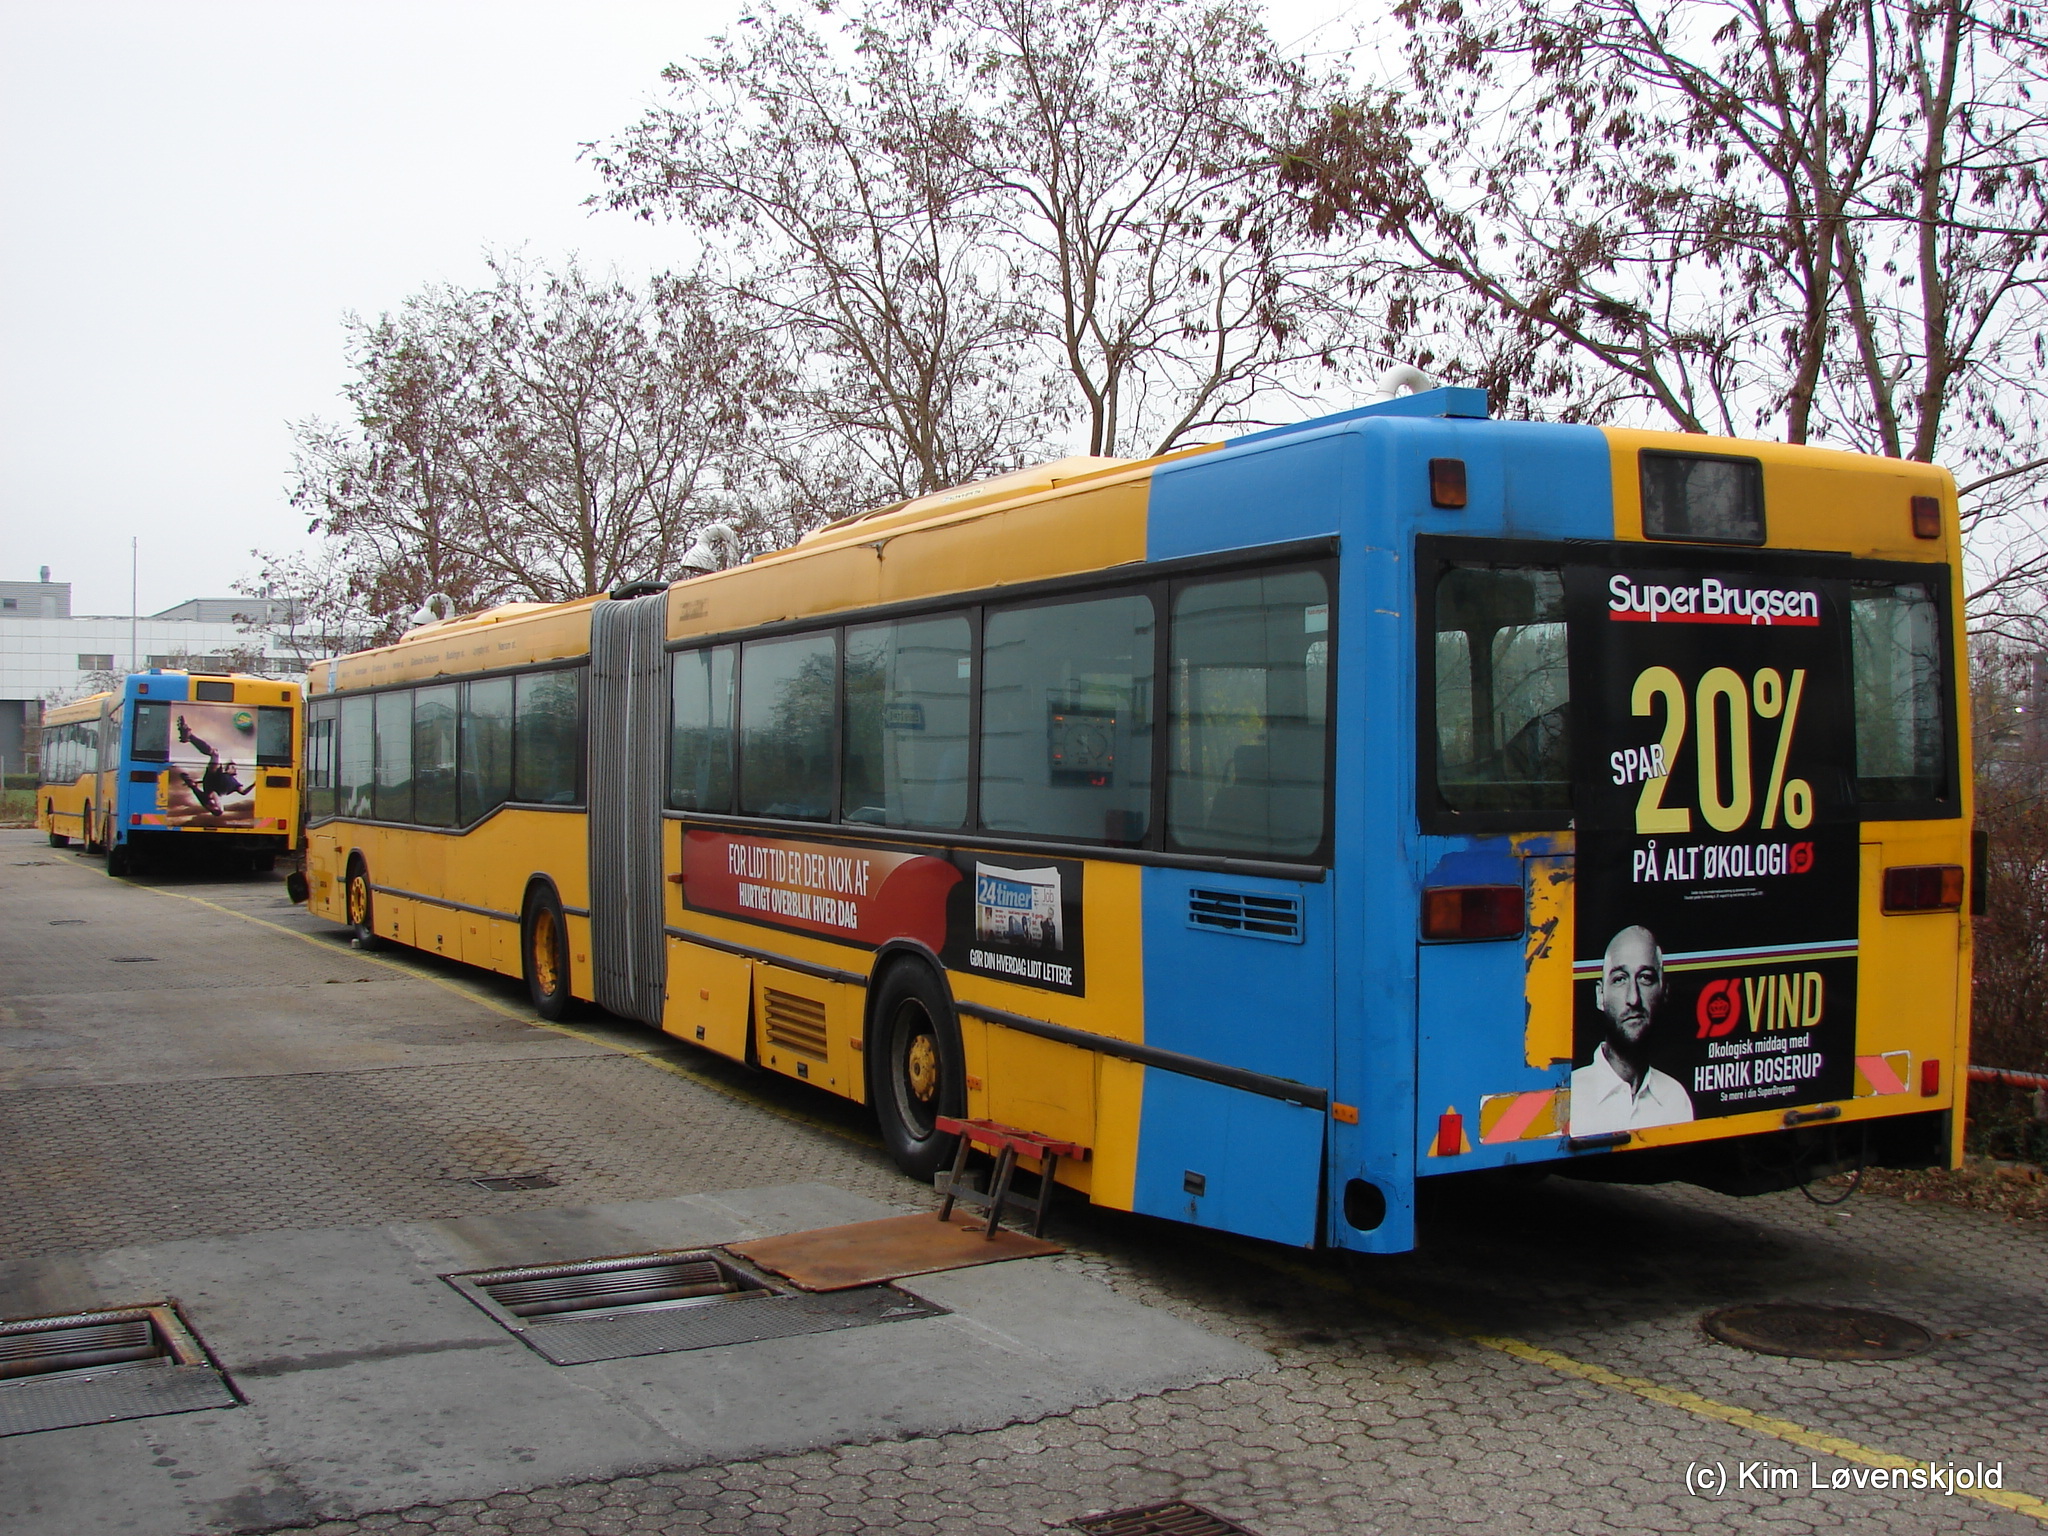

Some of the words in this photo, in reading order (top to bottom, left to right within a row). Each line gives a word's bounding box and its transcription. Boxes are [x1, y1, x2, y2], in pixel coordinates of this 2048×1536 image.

[1608, 574, 1820, 626] SuperBrugsen
[1610, 743, 1668, 786] SPAR
[1631, 666, 1814, 835] 20%
[728, 843, 747, 877] FOR
[748, 845, 768, 880] LIDT
[769, 848, 786, 883] TID
[788, 850, 802, 886] ER
[804, 852, 826, 890] DER
[828, 855, 853, 895] NOK
[854, 859, 870, 897] AF
[1633, 839, 1659, 883] PÅ
[1703, 843, 1787, 880] ØKOLOGI
[739, 881, 771, 912] HURTIGT
[771, 887, 812, 921] OVERBLIK
[813, 894, 837, 926] HVER
[837, 899, 858, 930] DAG
[969, 948, 984, 968] GØR
[984, 951, 996, 971] DIN
[996, 953, 1026, 977] HVERDAG
[1027, 959, 1042, 980] LIDT
[1042, 962, 1073, 986] LETTERE
[1744, 970, 1823, 1033] VIND
[1708, 1038, 1754, 1060] Økologisk
[1755, 1035, 1787, 1054] middag
[1789, 1031, 1810, 1049] med
[1694, 1060, 1751, 1093] HENRIK
[1754, 1052, 1823, 1085] BOSERUP
[1720, 1091, 1728, 1102] Se
[1757, 1084, 1796, 1098] SuperBrugsen
